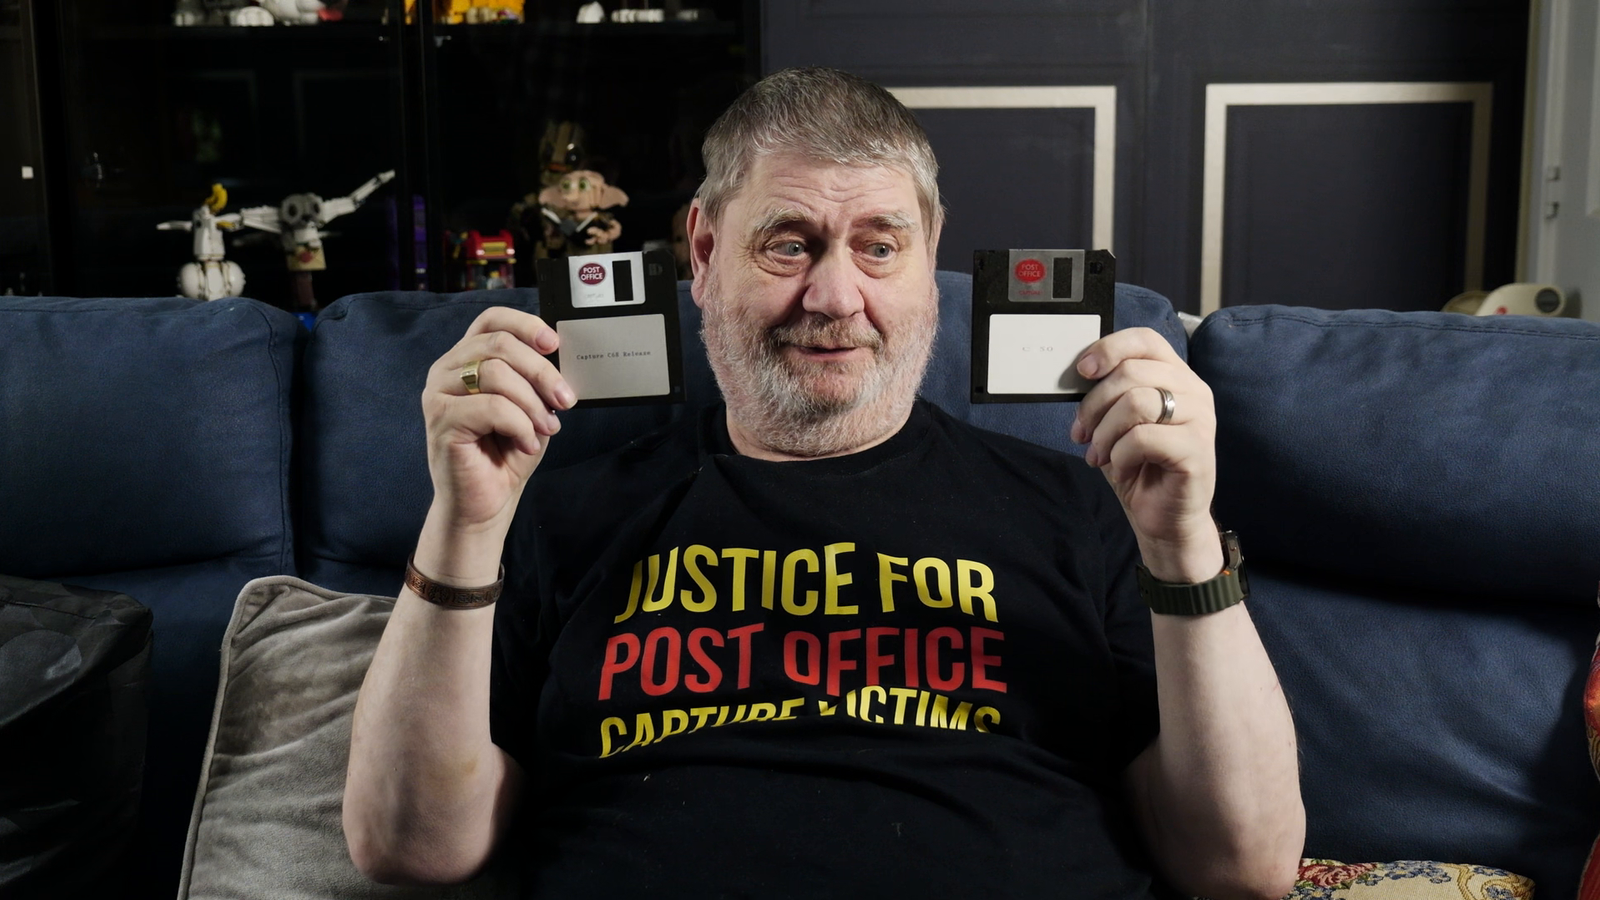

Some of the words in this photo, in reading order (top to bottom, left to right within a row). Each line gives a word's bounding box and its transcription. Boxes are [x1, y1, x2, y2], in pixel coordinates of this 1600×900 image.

[583, 266, 600, 274] POST
[1018, 270, 1040, 278] OFFICE
[580, 273, 603, 281] OFFICE
[576, 353, 604, 361] Capture
[614, 542, 859, 624] JUSTICE
[877, 551, 999, 623] FOR
[598, 622, 765, 701] POST
[783, 626, 1008, 697] OFFICE
